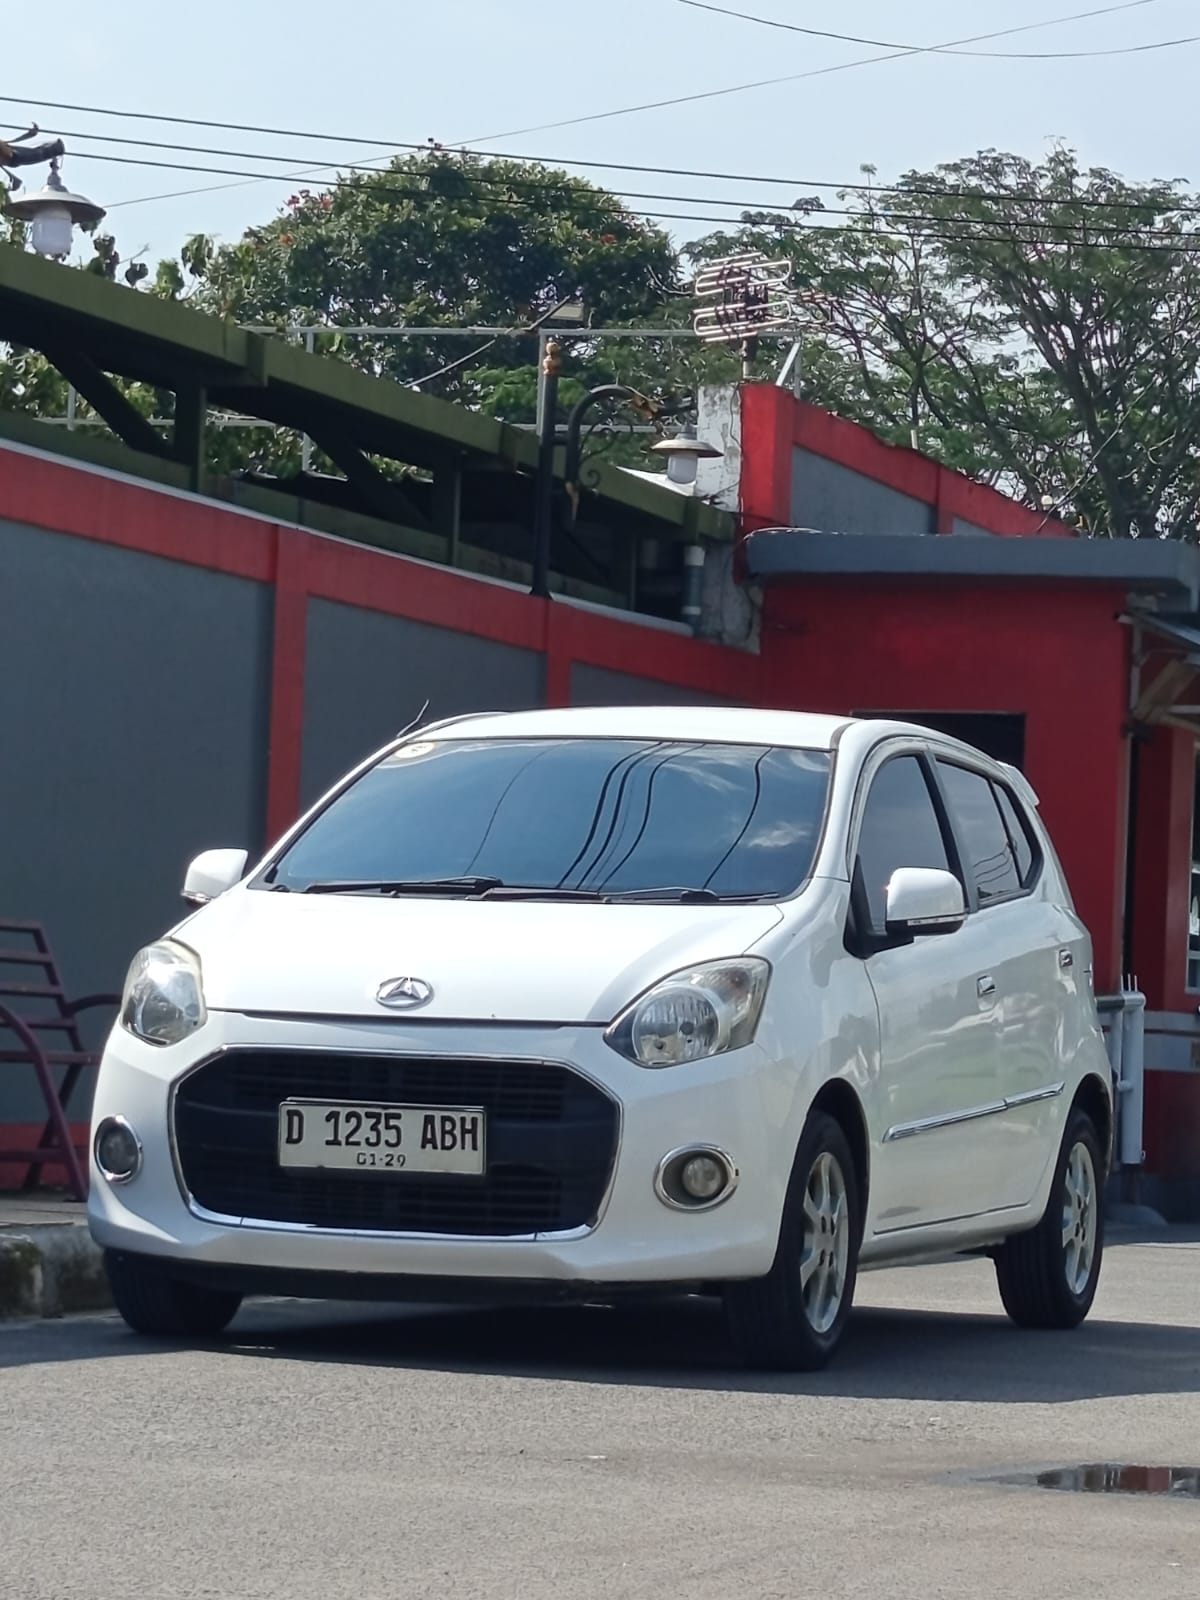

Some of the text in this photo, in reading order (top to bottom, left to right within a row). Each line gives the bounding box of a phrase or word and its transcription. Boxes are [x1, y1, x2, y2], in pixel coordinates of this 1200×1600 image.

[285, 1109, 479, 1151] D 1235 ABH
